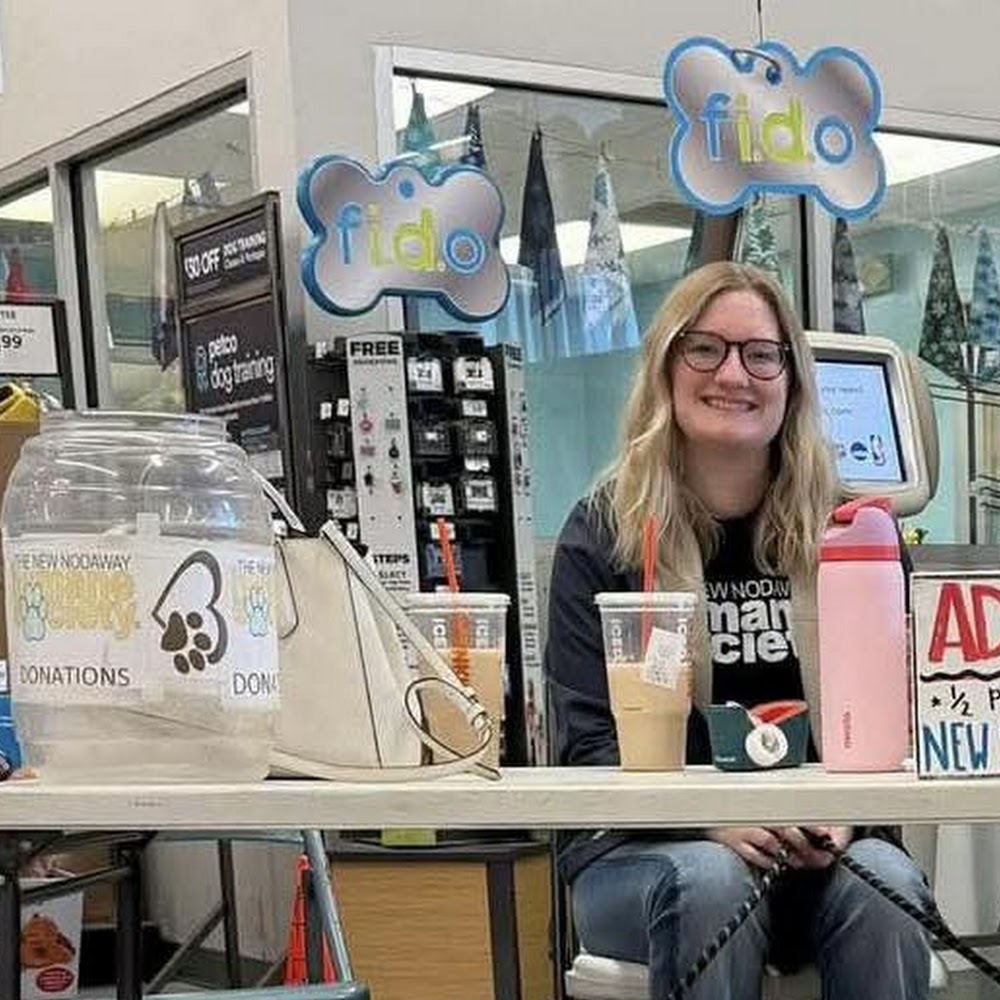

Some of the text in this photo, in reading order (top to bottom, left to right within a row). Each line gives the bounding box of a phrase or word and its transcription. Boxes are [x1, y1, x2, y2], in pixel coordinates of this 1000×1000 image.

[201, 247, 221, 275] OFF
[208, 333, 238, 363] petco
[349, 341, 400, 357] FREE
[210, 350, 275, 393] dog training
[60, 553, 131, 570] NODAWAY
[20, 664, 131, 687] DONATIONS
[922, 720, 989, 772] NEW
